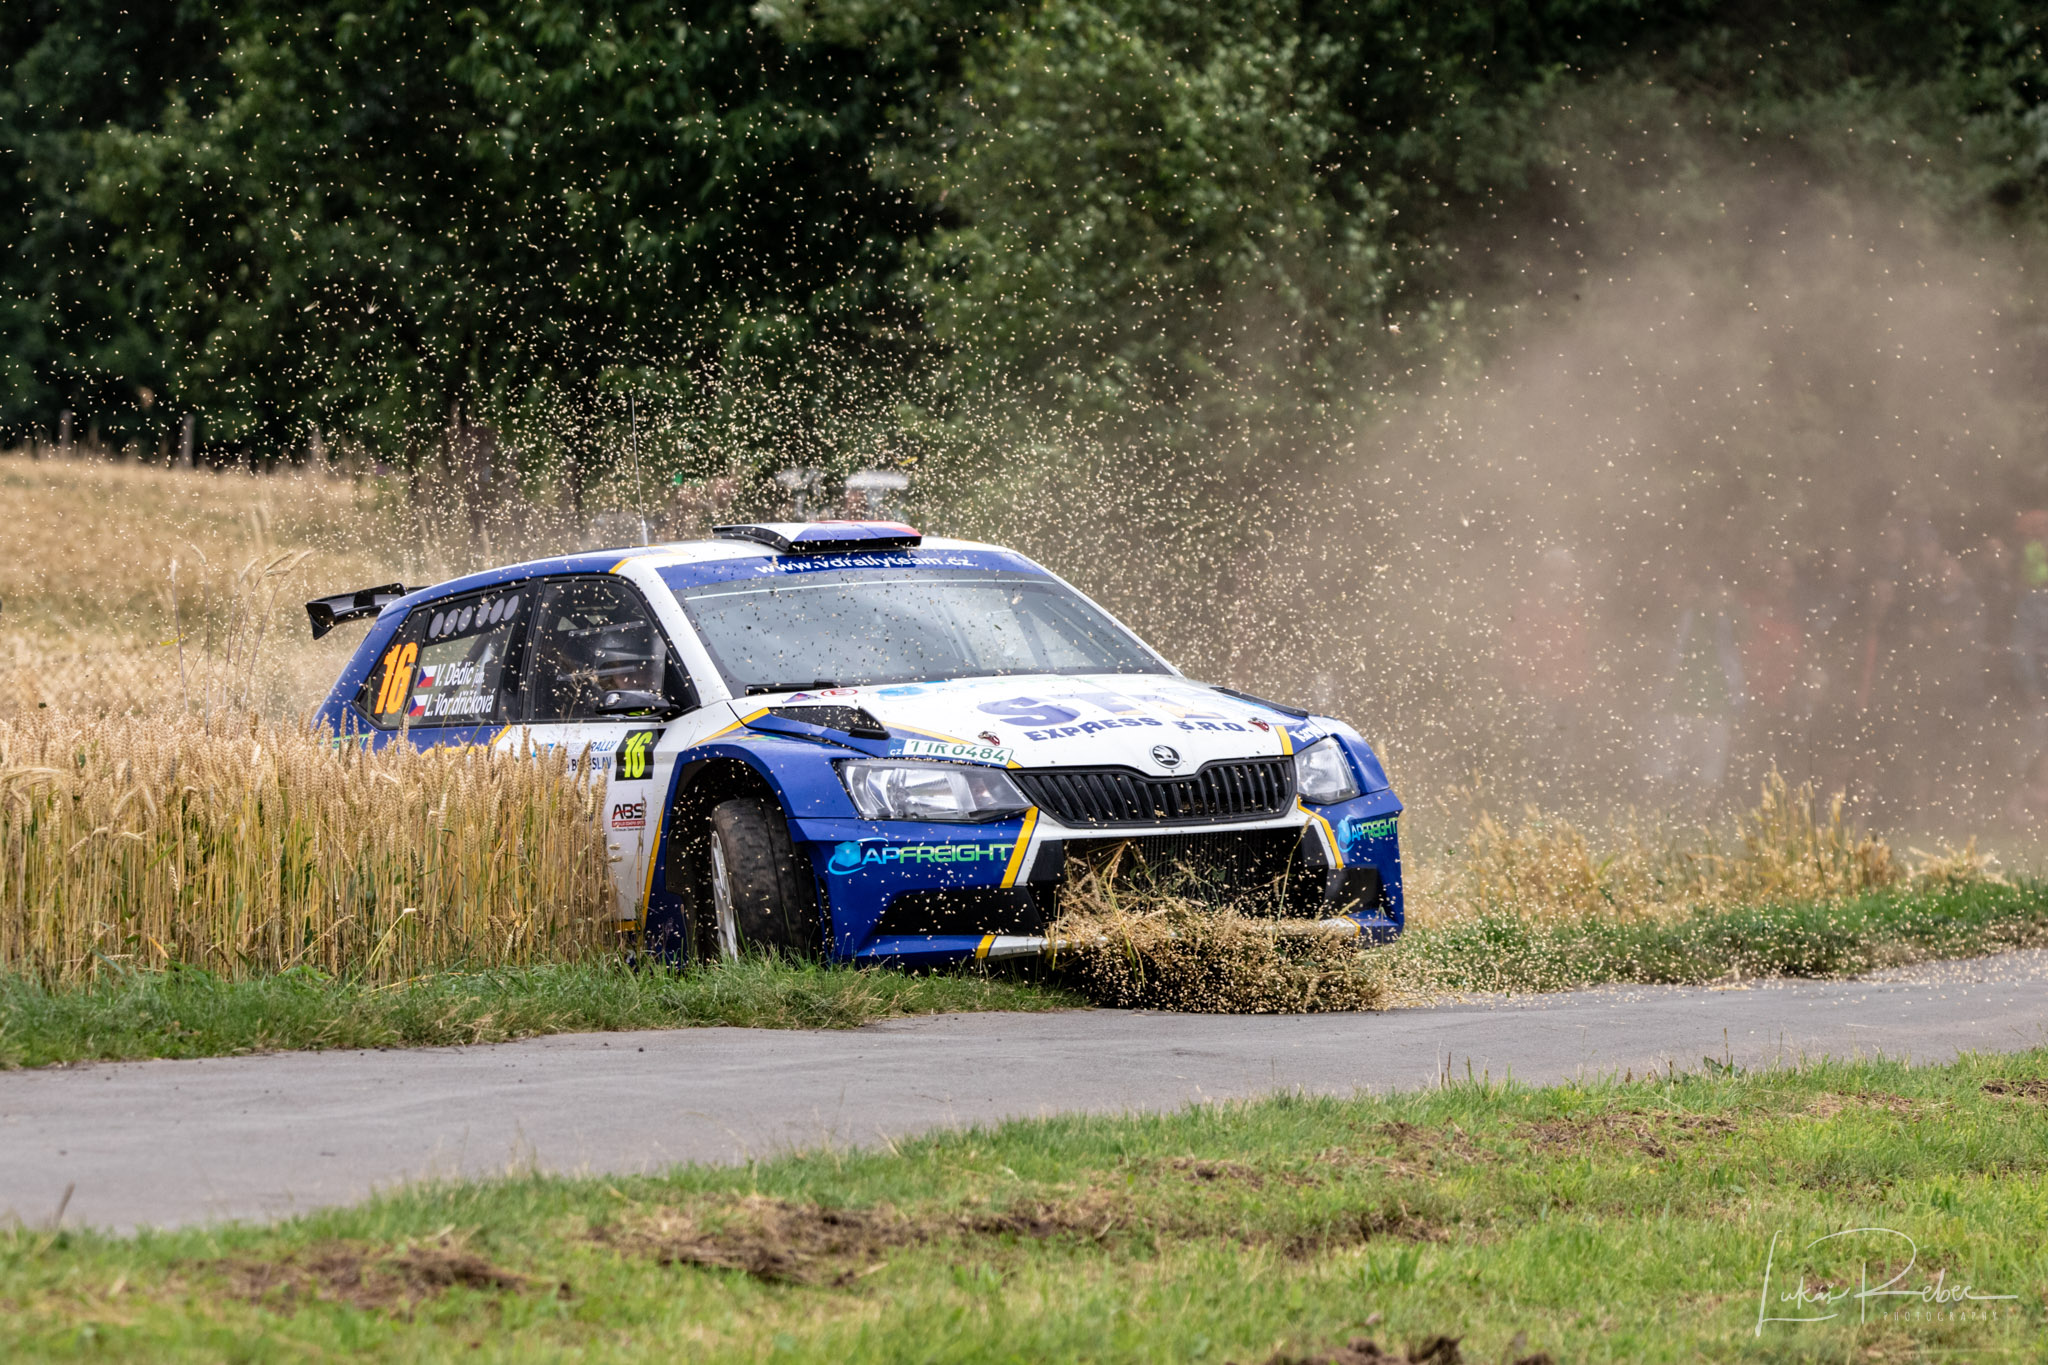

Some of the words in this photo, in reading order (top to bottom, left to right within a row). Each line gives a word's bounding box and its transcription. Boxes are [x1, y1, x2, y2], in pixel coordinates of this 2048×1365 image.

[374, 642, 418, 714] 16
[435, 664, 445, 687] V.
[424, 693, 433, 717] L.
[1024, 717, 1163, 742] EXPRESS
[624, 731, 653, 778] 16
[951, 745, 1006, 762] 0484
[612, 803, 644, 819] ABS
[861, 844, 1015, 865] APFREIGHT
